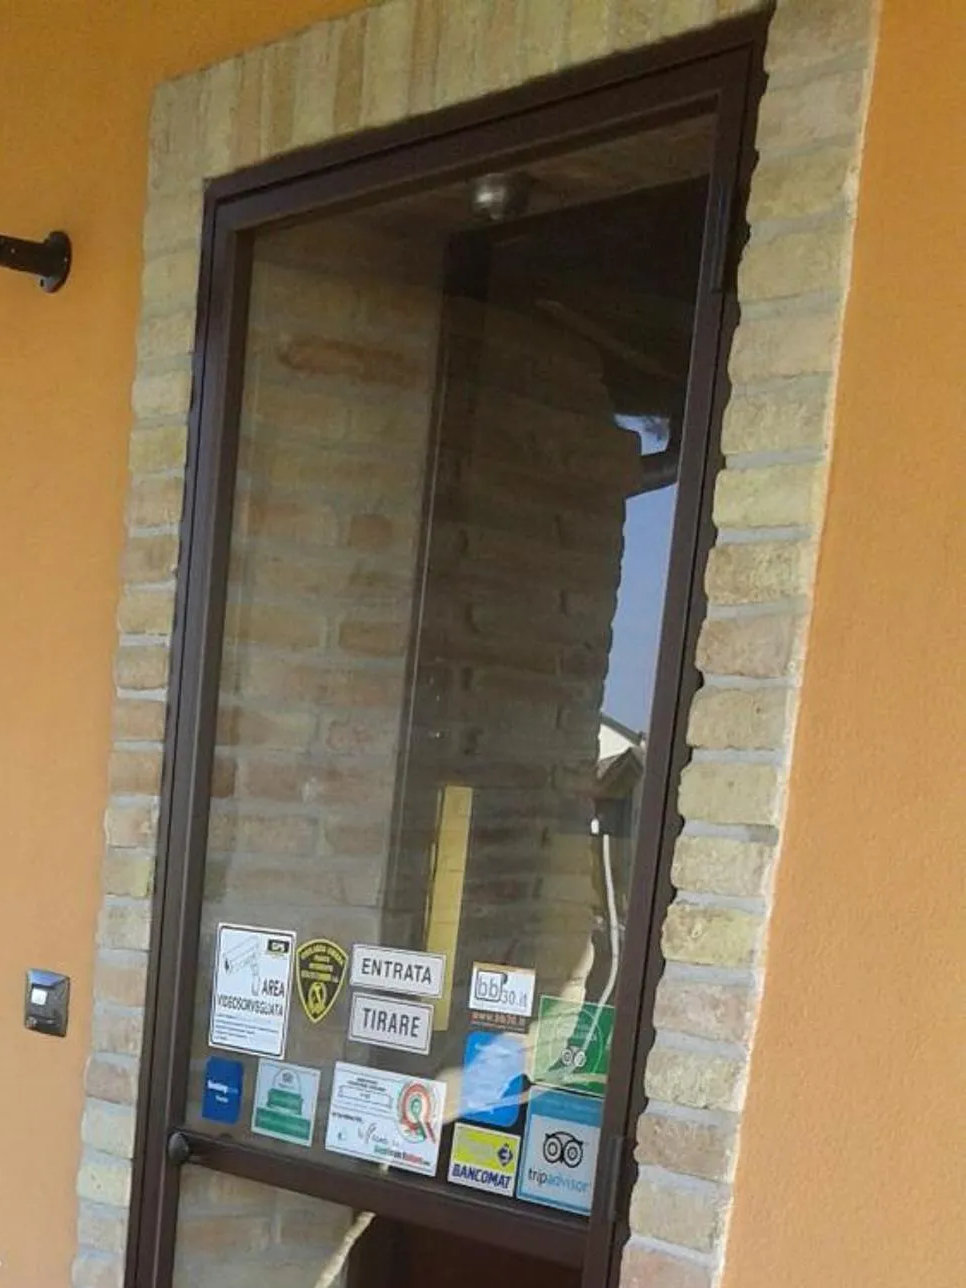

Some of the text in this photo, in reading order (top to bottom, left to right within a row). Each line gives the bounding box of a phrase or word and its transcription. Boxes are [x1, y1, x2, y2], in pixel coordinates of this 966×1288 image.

[361, 957, 432, 985] ENTRATA
[261, 979, 285, 998] AREA
[362, 1007, 421, 1038] TIRARE
[452, 1163, 513, 1189] BANCOMAT
[527, 1167, 589, 1193] tripadvisor
